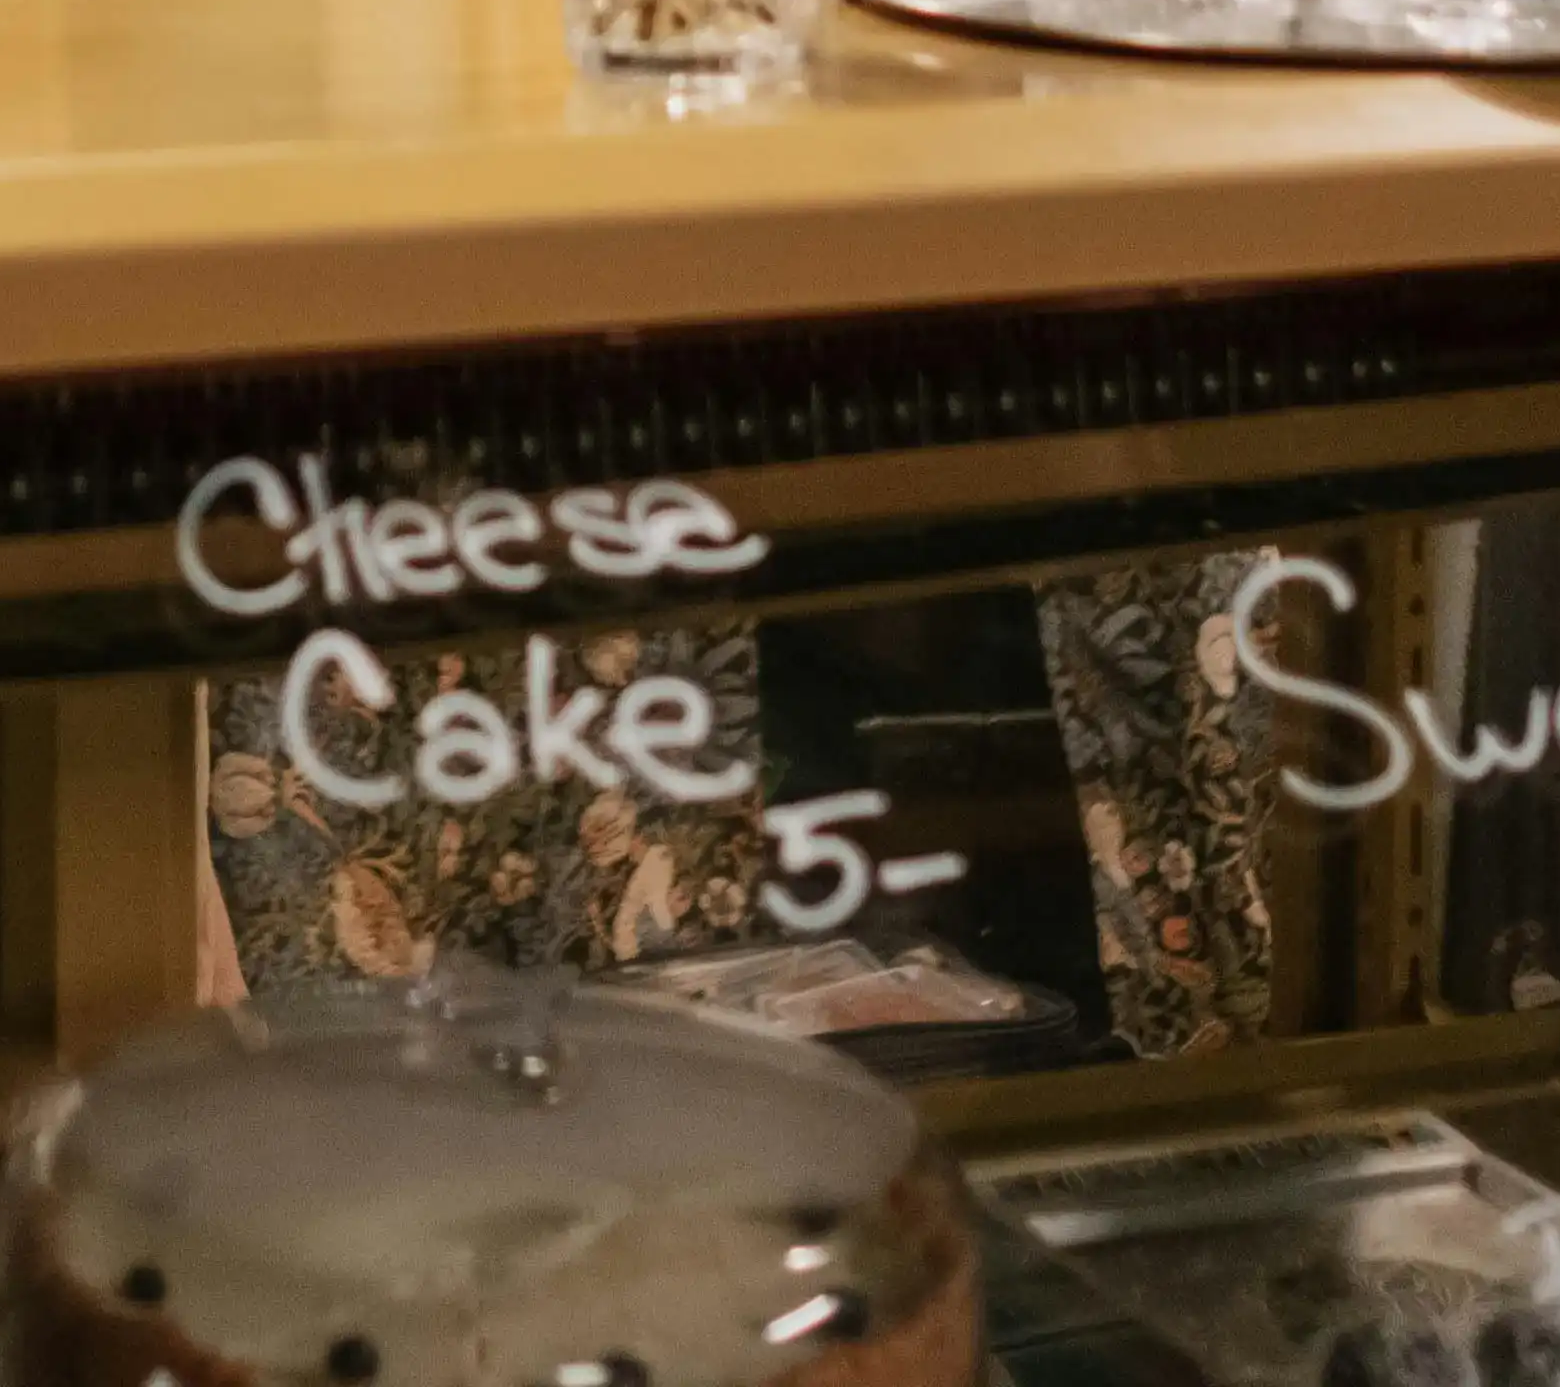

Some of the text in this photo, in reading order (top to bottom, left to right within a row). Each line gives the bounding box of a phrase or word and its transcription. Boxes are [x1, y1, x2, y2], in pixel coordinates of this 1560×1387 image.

[175, 451, 772, 618] Cheese
[282, 628, 760, 811] Cake
[756, 788, 968, 933] 5-
